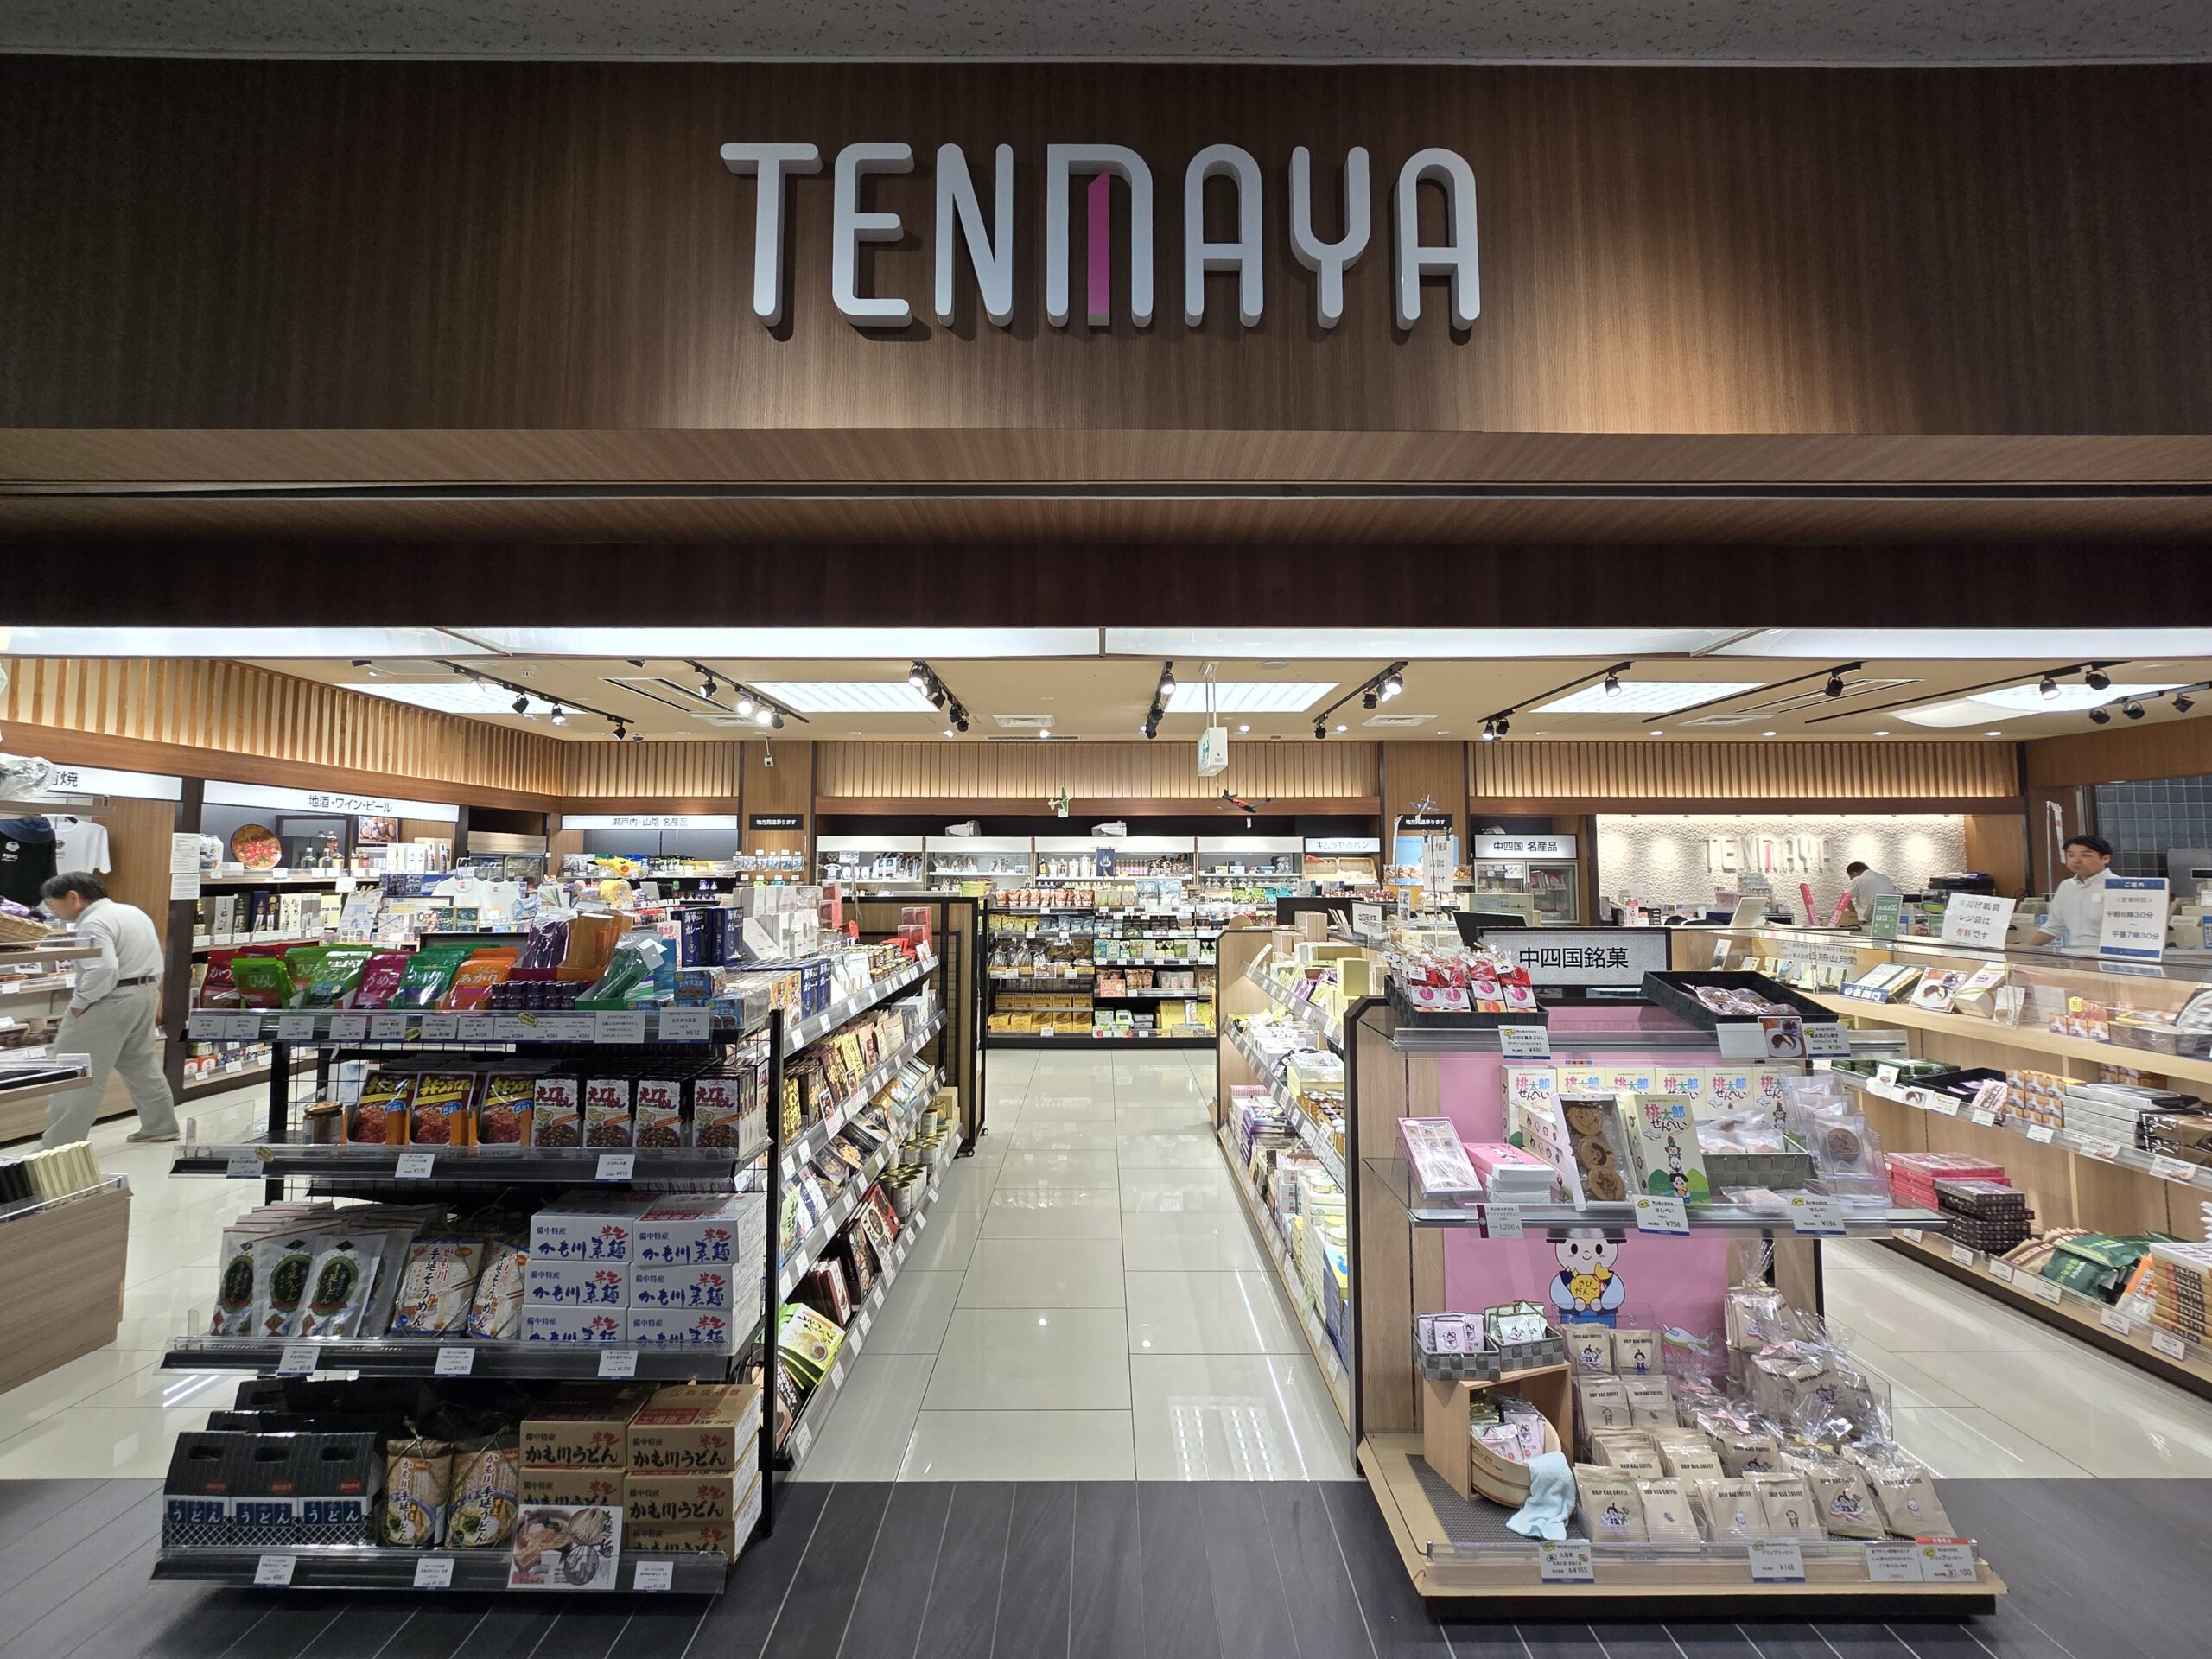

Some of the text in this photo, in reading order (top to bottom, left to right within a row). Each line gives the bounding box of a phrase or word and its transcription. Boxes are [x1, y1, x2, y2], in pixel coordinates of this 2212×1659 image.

[719, 143, 1481, 331] TENMAYA
[308, 794, 393, 813] 地酒・ワイン・ビール
[663, 817, 688, 827] 名産品
[1316, 840, 1370, 850] キムラヤのパン
[1493, 841, 1557, 852] 中四国 名産品
[1700, 836, 1833, 874] TENMAYA
[1959, 899, 2001, 912] 手提げ紙袋
[1958, 914, 1992, 925] レジ袋は
[2106, 910, 2154, 920] 午前6時30分
[1955, 928, 1989, 939] 有料です
[2111, 931, 2160, 940] 午後7時30分
[1518, 946, 1629, 969] 中四国銘菓
[456, 972, 499, 985] あかり
[1515, 1077, 1550, 1091] 桃太郎
[1613, 1077, 1649, 1090] 桃太郎
[1664, 1077, 1699, 1091] 桃太郎
[1712, 1077, 1747, 1091] 桃太郎
[1644, 1103, 1687, 1122] 桃太郎
[1650, 1119, 1688, 1133] せんべい
[537, 1237, 626, 1261] かも川素麺
[641, 1240, 731, 1265] かも川素麺
[435, 1247, 454, 1281] かも川
[412, 1247, 441, 1328] 手延そうめん
[1578, 1279, 1593, 1287] きび
[532, 1281, 620, 1306] かも川素麺
[638, 1284, 725, 1308] かも川素麺
[1574, 1287, 1598, 1296] だんご
[400, 1459, 414, 1490] かも川
[481, 1453, 499, 1484] かも川
[172, 1508, 222, 1524] うどん
[238, 1510, 290, 1526] うどん
[309, 1509, 363, 1523] うどん
[475, 1486, 494, 1543] 手延うどん
